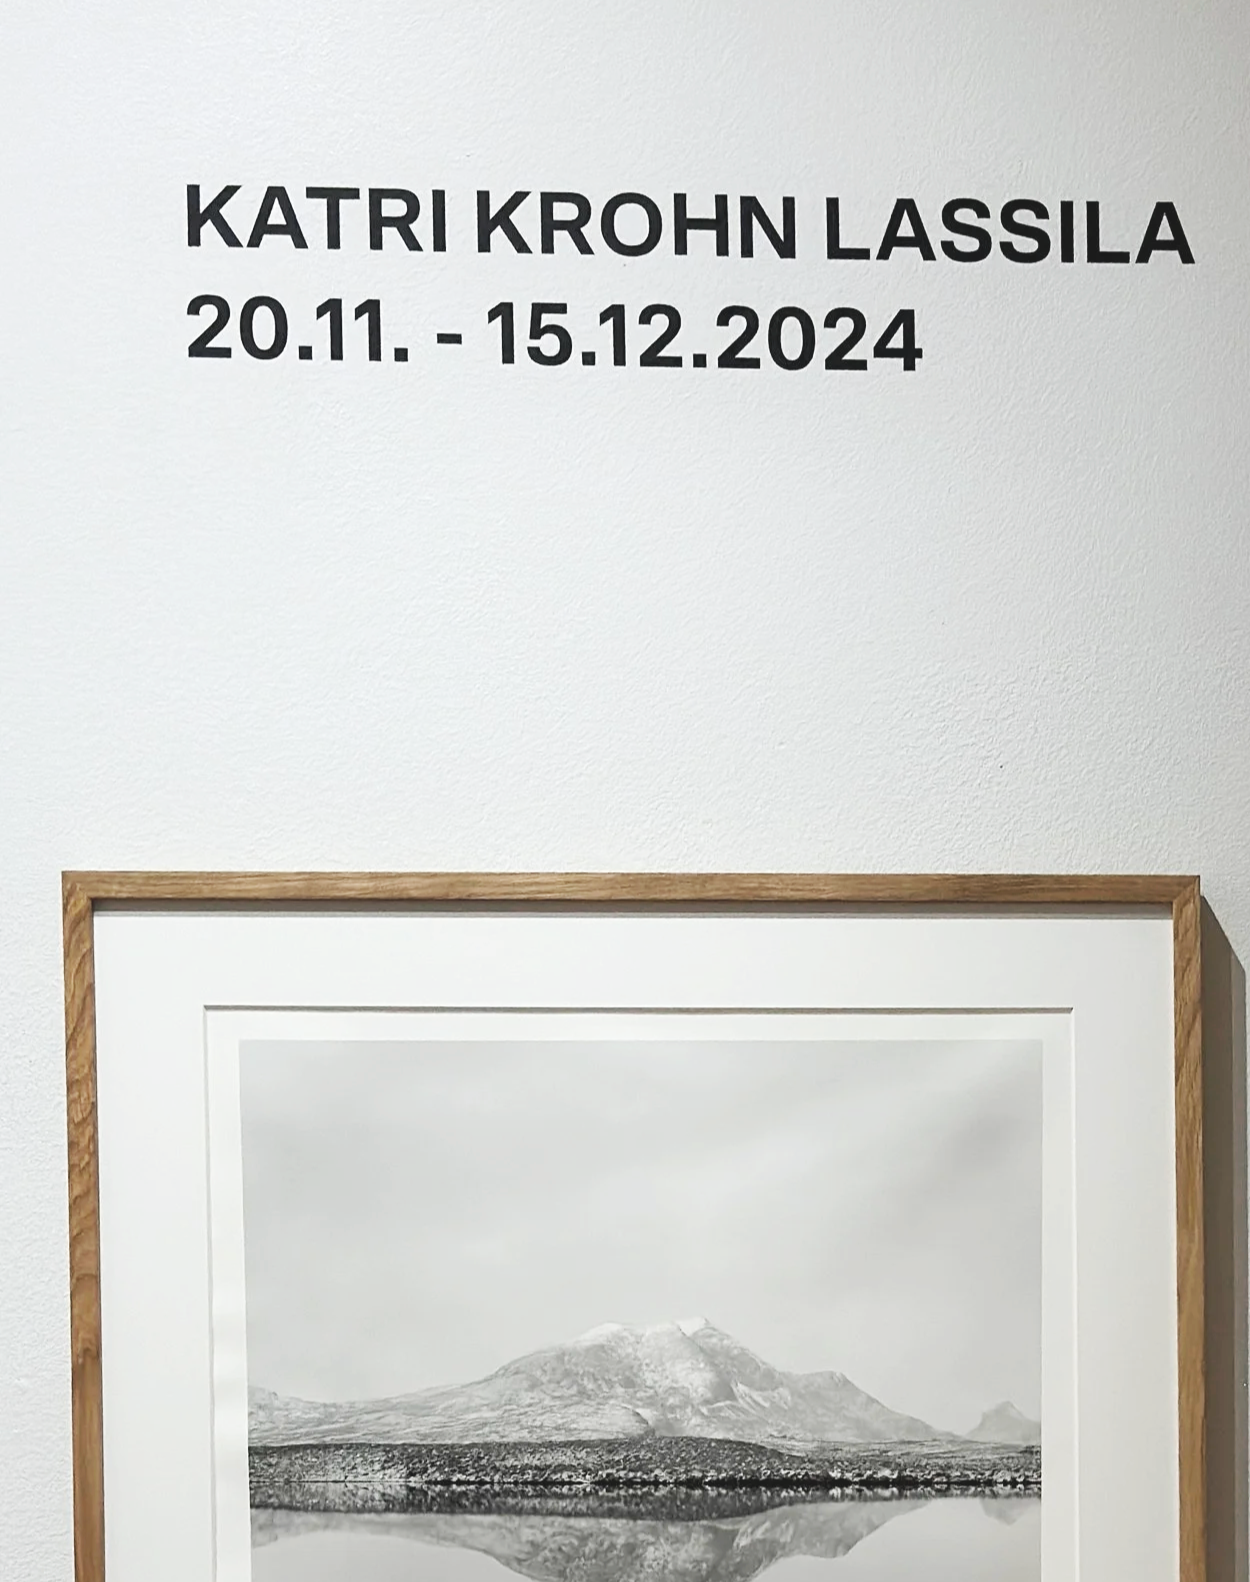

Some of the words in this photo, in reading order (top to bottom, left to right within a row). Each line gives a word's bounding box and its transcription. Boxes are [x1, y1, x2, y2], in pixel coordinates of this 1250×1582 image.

[186, 184, 447, 252] KATRI
[476, 190, 796, 259] KROHN
[825, 197, 1196, 265] LASSILA
[186, 294, 409, 362] 20.11.
[436, 333, 463, 345] -
[487, 302, 923, 372] 15.12.2024
